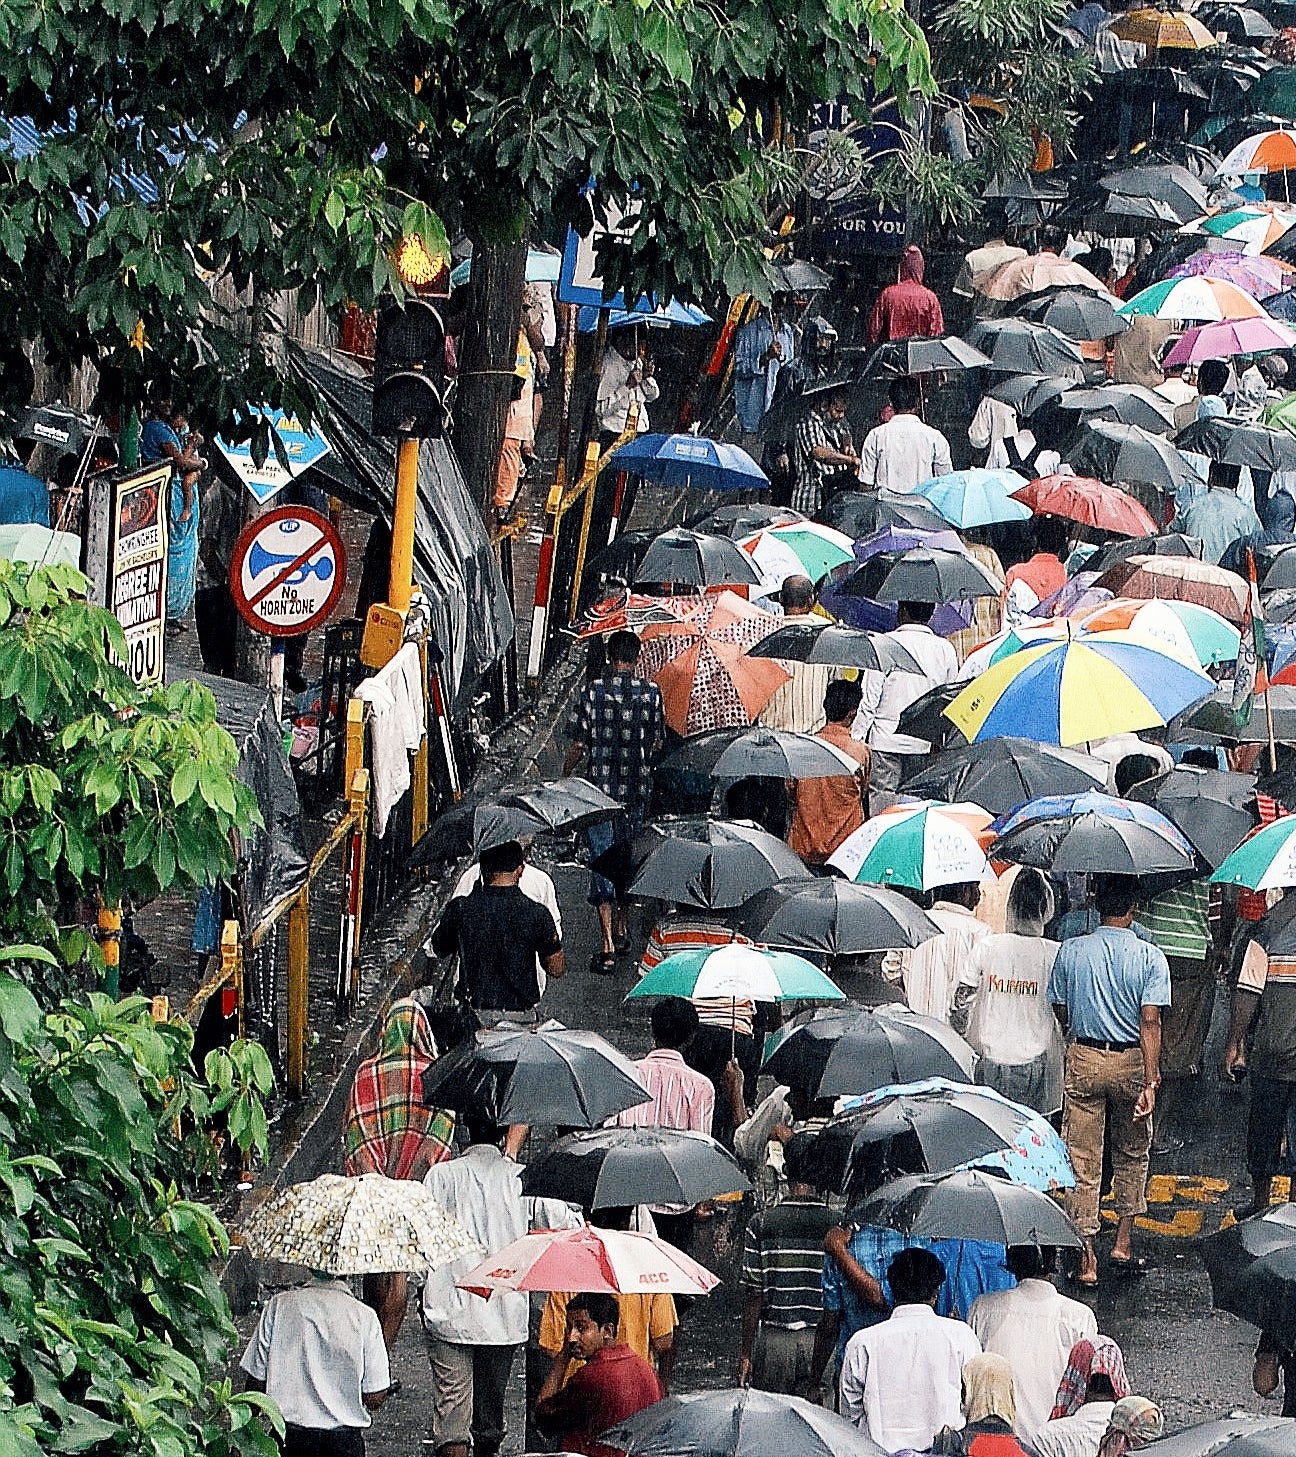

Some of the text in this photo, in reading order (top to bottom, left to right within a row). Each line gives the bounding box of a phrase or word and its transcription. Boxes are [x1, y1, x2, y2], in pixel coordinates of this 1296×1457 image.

[872, 219, 906, 235] YOU
[149, 561, 161, 592] IN
[281, 586, 298, 599] No
[260, 599, 315, 615] HORN ZONE
[639, 1272, 670, 1284] ACC
